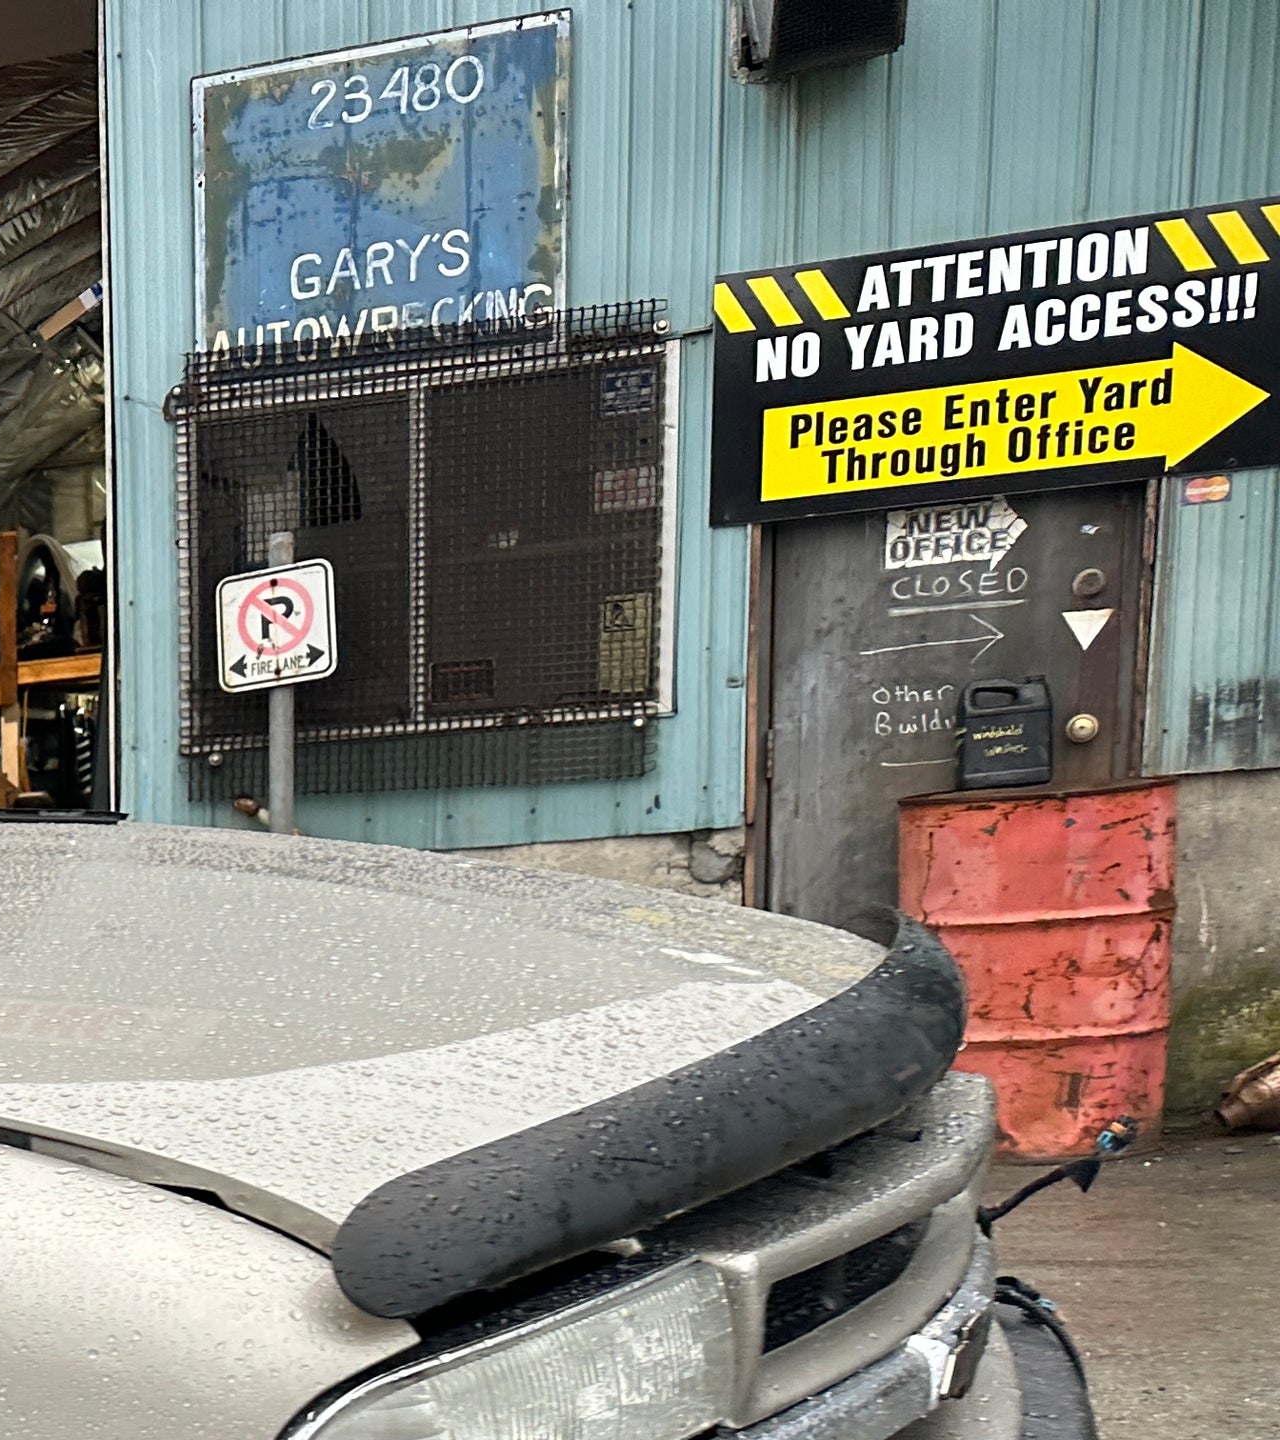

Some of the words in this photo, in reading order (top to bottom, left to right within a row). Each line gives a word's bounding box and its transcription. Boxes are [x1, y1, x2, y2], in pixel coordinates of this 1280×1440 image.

[307, 55, 484, 129] 23480
[290, 228, 471, 301] GARY'S
[856, 225, 1150, 314] ATTENTION
[754, 331, 821, 383] NO
[844, 310, 975, 371] YARD
[998, 272, 1258, 352] ACCESS!!!
[789, 405, 922, 449] Please
[944, 385, 1057, 431] Enter
[1079, 368, 1174, 414] Yard
[821, 433, 986, 484] Through
[1007, 421, 1137, 463] Office
[890, 529, 1011, 562] OFFICE
[905, 503, 990, 536] NEW
[892, 567, 1028, 600] CLOSED
[251, 659, 273, 677] FIRE
